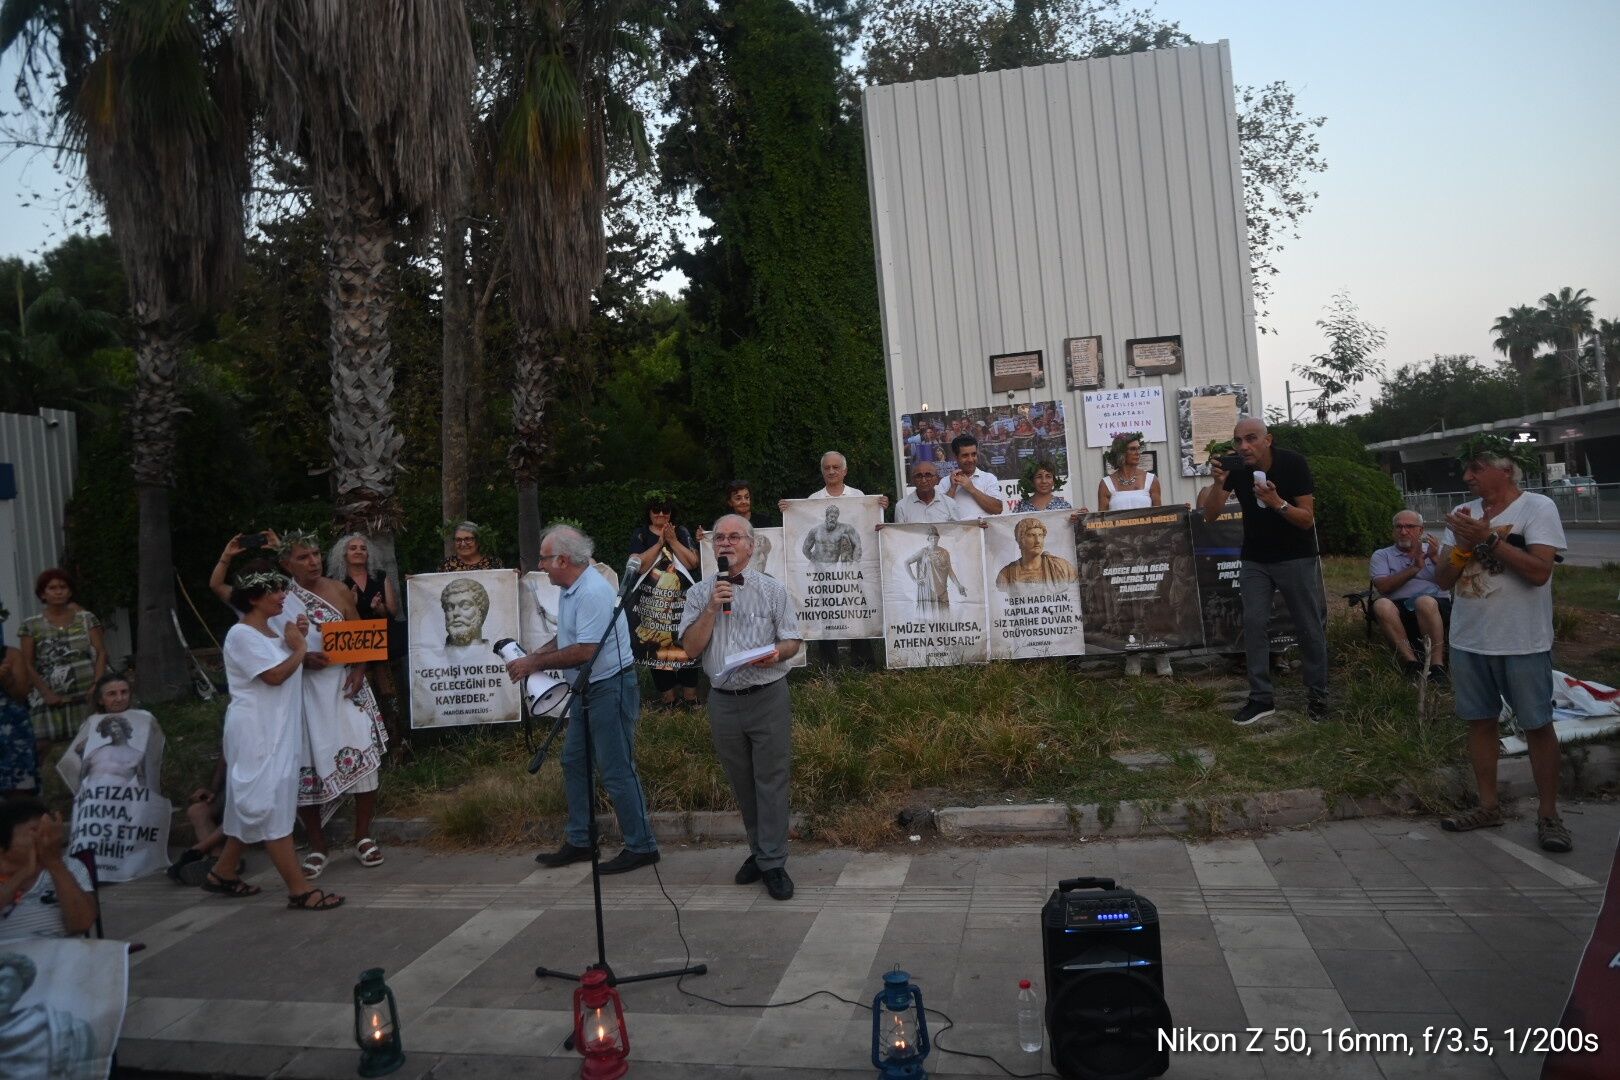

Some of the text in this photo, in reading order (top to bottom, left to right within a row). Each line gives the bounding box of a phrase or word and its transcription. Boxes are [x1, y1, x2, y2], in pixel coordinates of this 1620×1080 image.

[1085, 388, 1160, 403] MÜZEMİZİN
[1098, 419, 1152, 429] YIKIMININ
[808, 584, 863, 595] KORUDUM,
[804, 596, 867, 608] SİZ KOLAYCA
[1004, 606, 1040, 617] KAPILAR
[928, 621, 982, 633] YIKILIRSA,
[1009, 616, 1039, 628] TARİHE
[1041, 615, 1073, 625] DUVAR
[893, 637, 935, 649] ATHENA
[462, 664, 484, 675] YOK
[429, 678, 502, 692] GELECEĞİNİ DE
[117, 825, 160, 842] ETME
